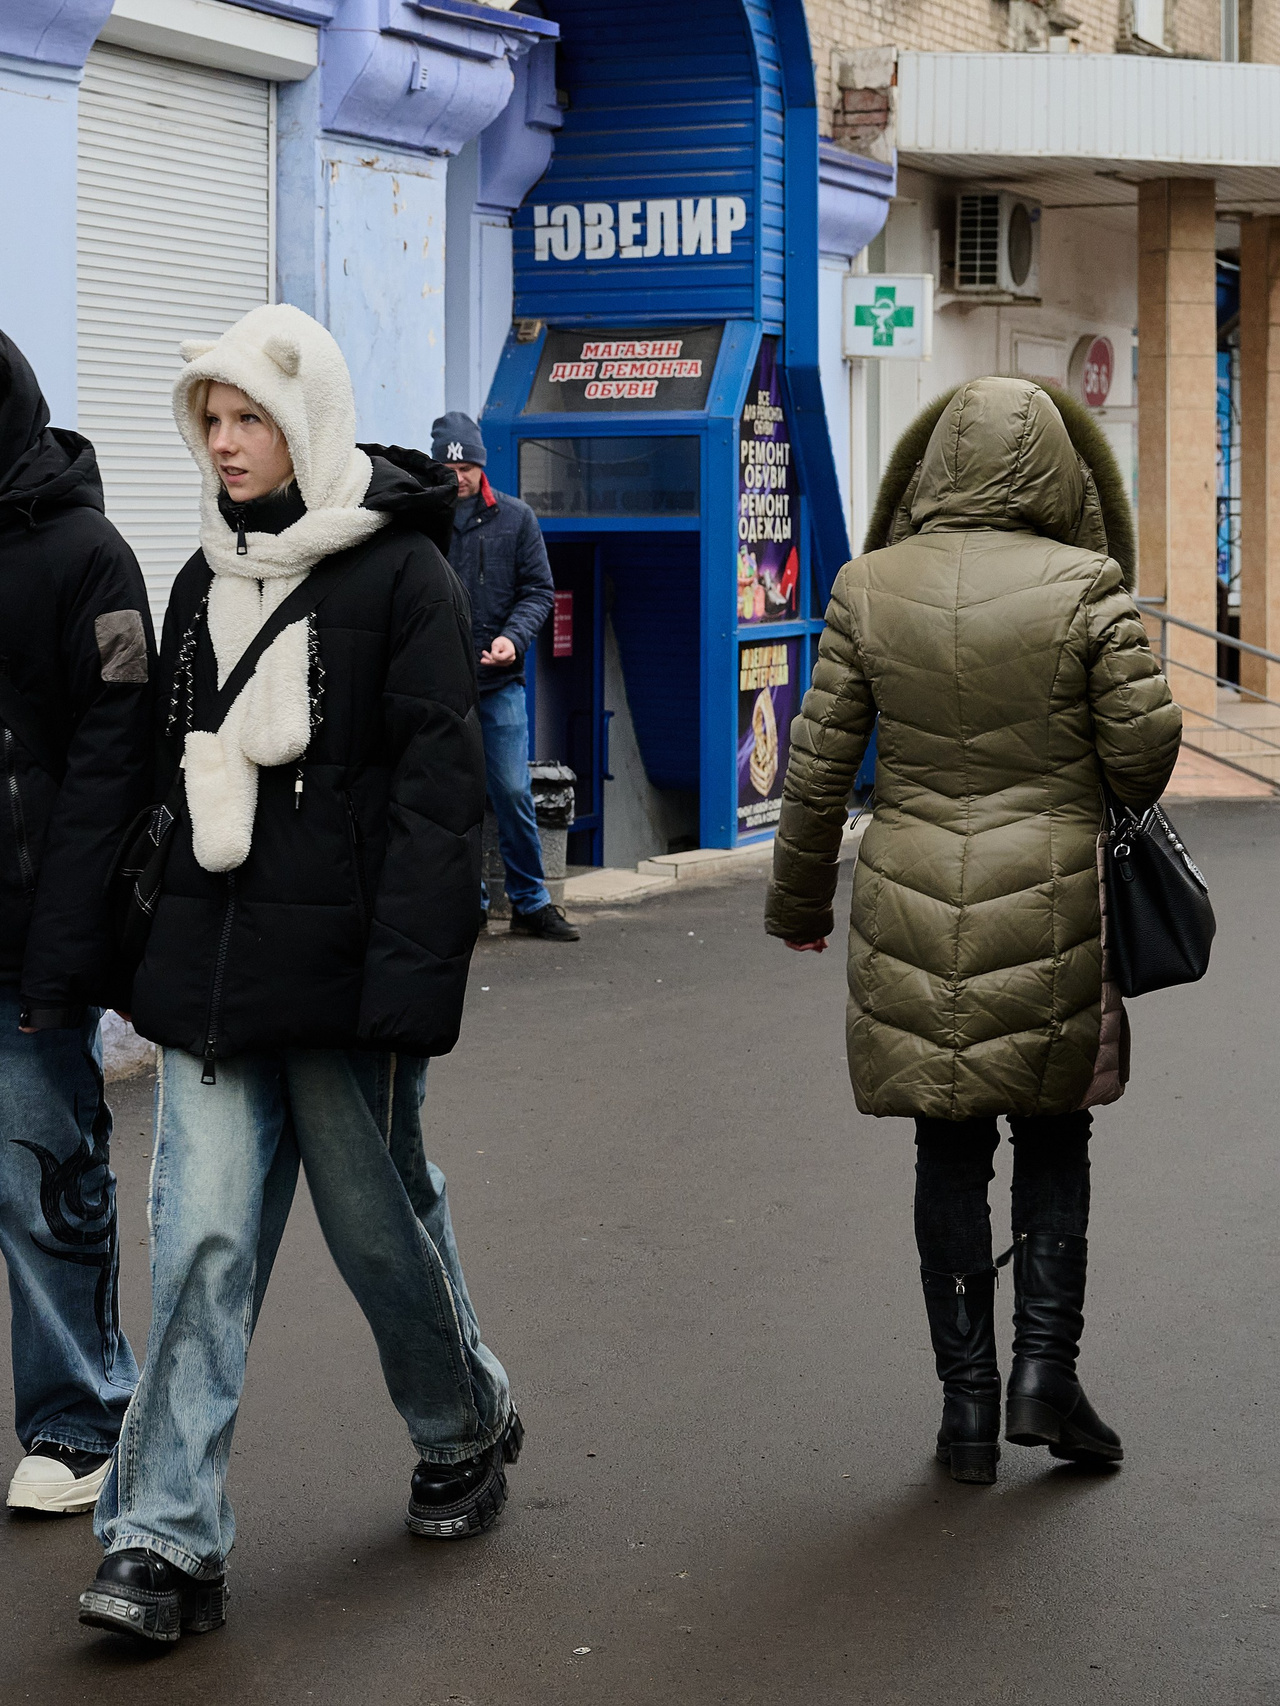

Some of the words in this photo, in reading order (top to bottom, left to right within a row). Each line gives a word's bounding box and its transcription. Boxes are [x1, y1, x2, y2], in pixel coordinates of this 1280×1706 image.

[534, 196, 746, 261] ЮВЕЛИР
[581, 341, 682, 358] МАГАЗИН
[550, 362, 597, 381] ДЛЯ
[600, 360, 701, 378] РЕМОНТА
[586, 381, 657, 398] ОБУВИ
[741, 440, 790, 466] РЕМОНТ
[745, 464, 786, 489] ОБУВИ
[741, 493, 789, 517] РЕМОНТ
[738, 516, 792, 543] ОДЕЖДЫ
